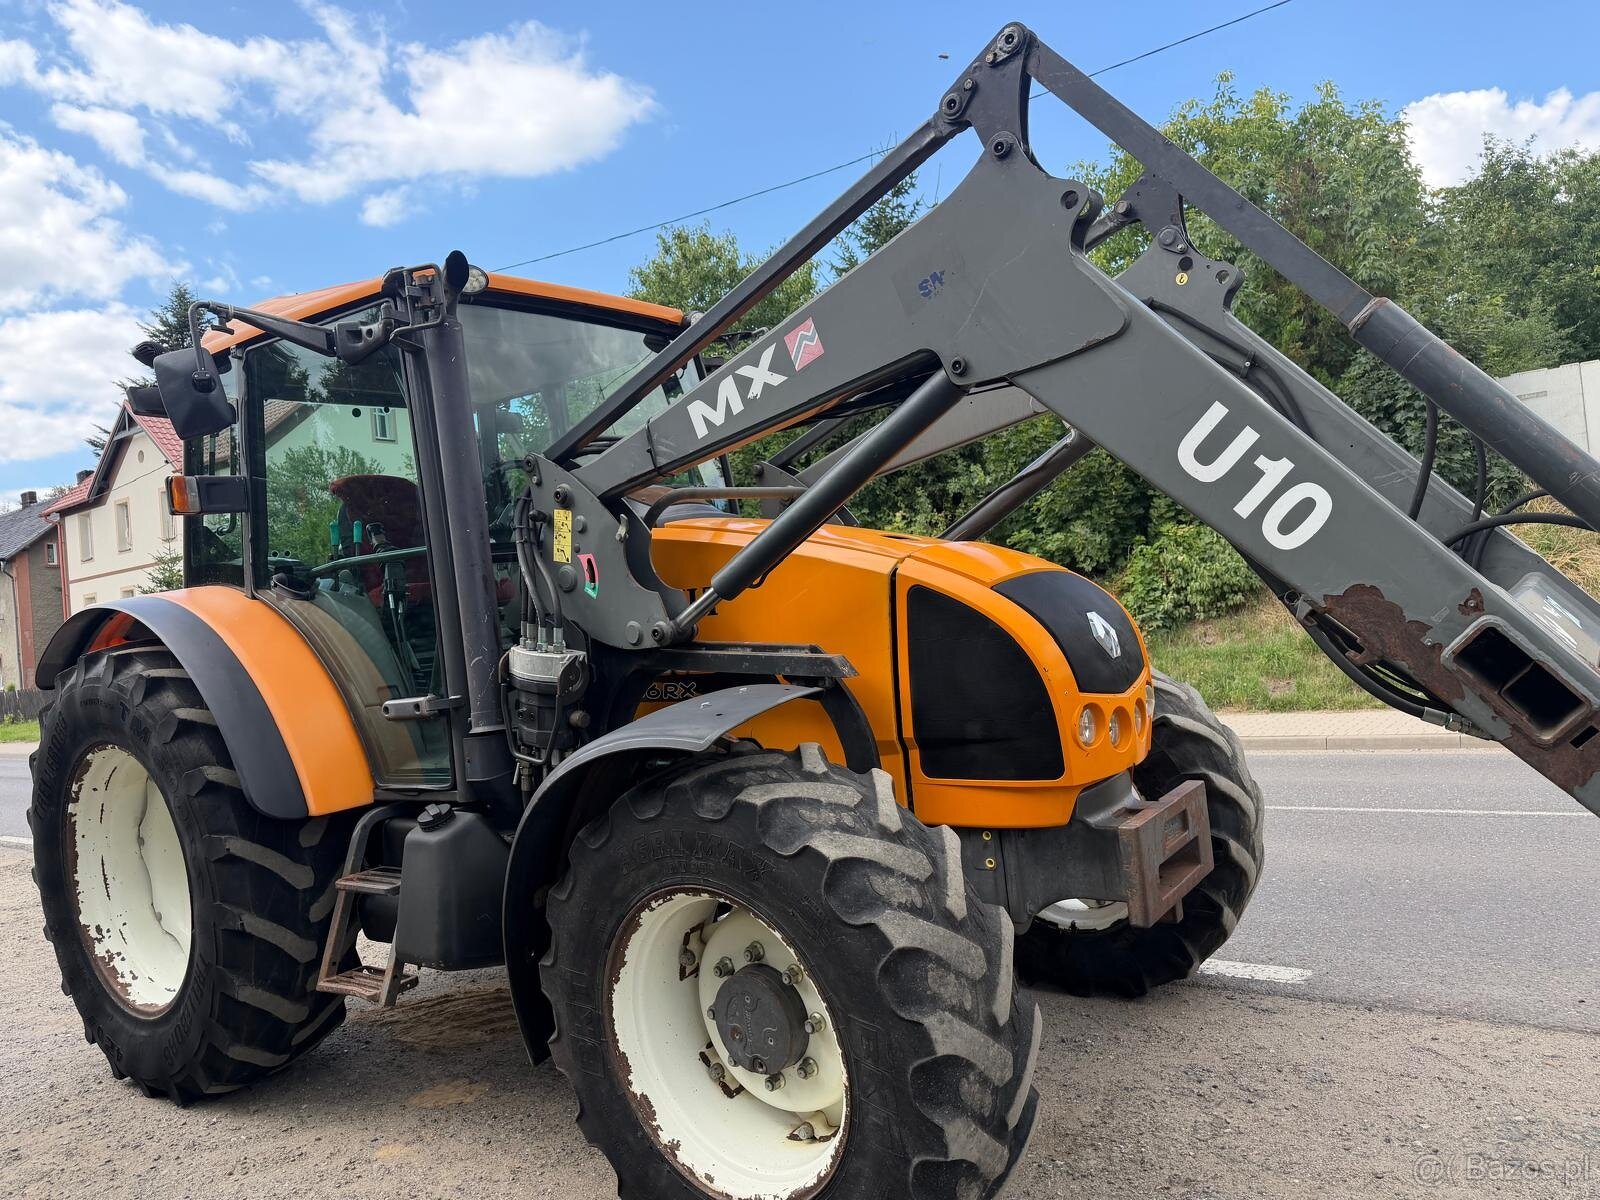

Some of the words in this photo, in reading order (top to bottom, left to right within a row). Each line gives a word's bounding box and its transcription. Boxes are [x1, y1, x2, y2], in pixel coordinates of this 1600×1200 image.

[686, 342, 789, 440] MX
[1177, 400, 1333, 551] U10
[642, 681, 698, 700] 6RX
